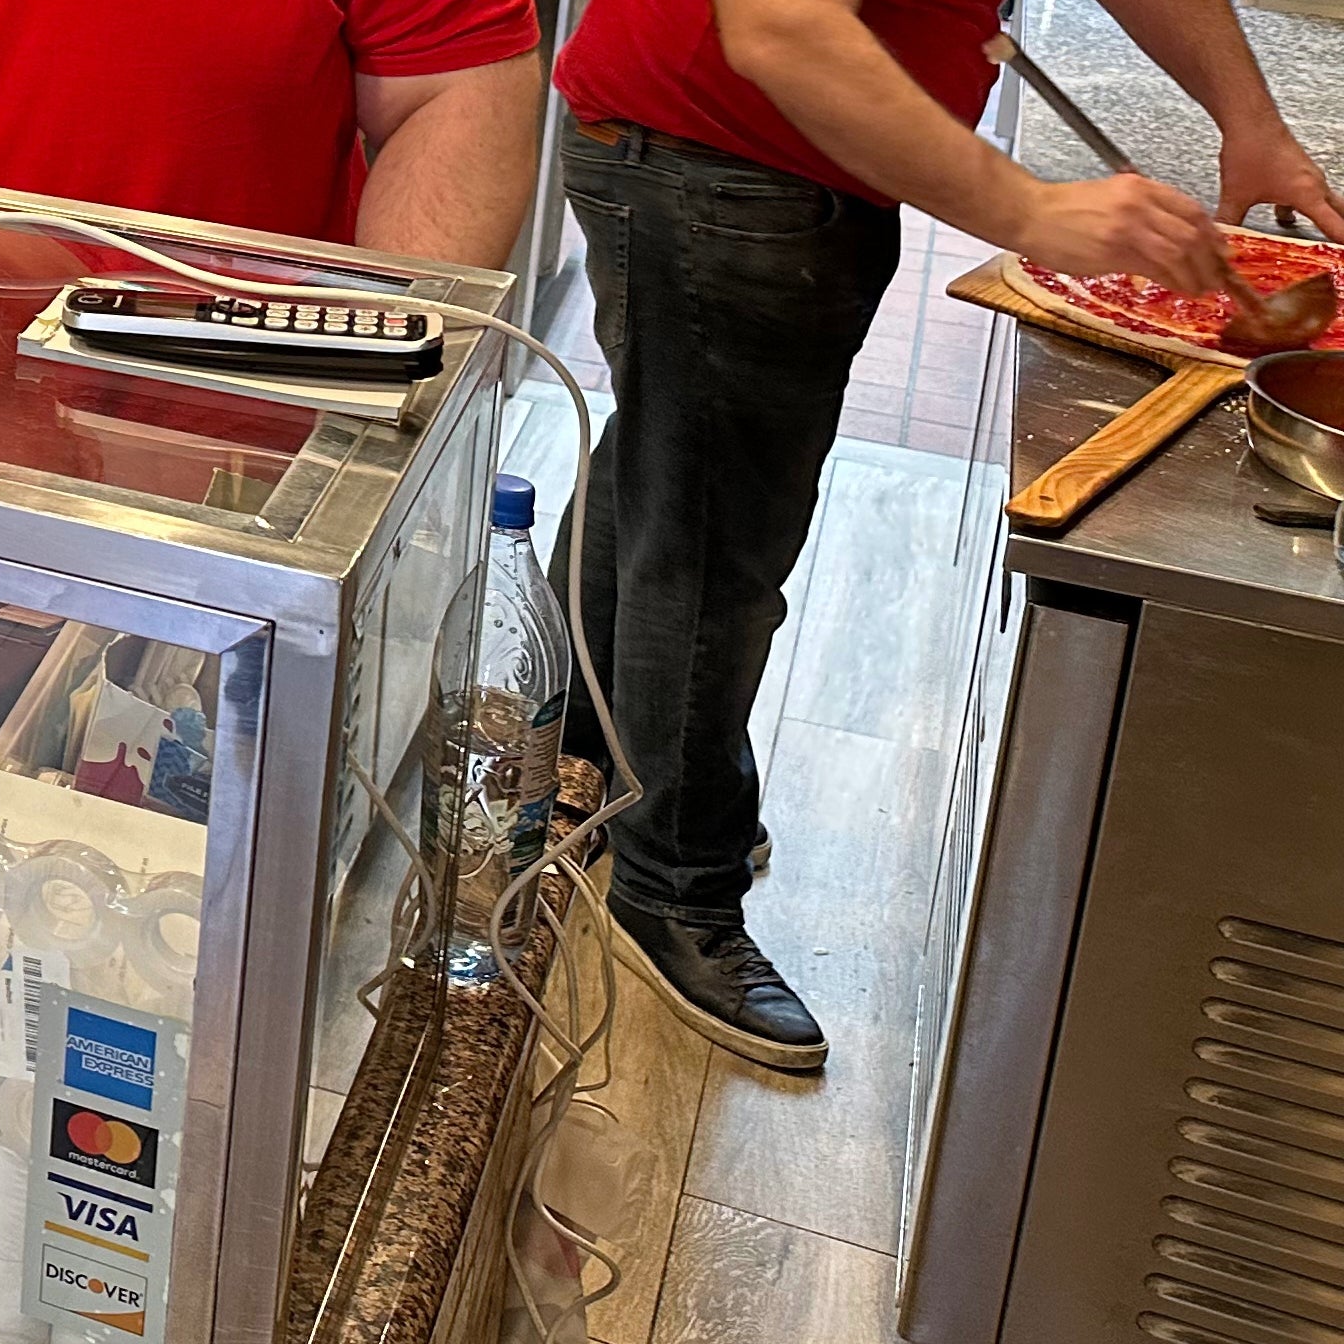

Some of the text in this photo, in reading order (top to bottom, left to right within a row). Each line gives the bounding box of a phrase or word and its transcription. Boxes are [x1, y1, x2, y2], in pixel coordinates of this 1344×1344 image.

[67, 1036, 149, 1068] AMERICAN
[84, 1057, 154, 1086] EXPRESS
[69, 1152, 137, 1178] mastercard
[57, 1191, 139, 1241] VISA
[46, 1263, 140, 1307] DISCOVER
